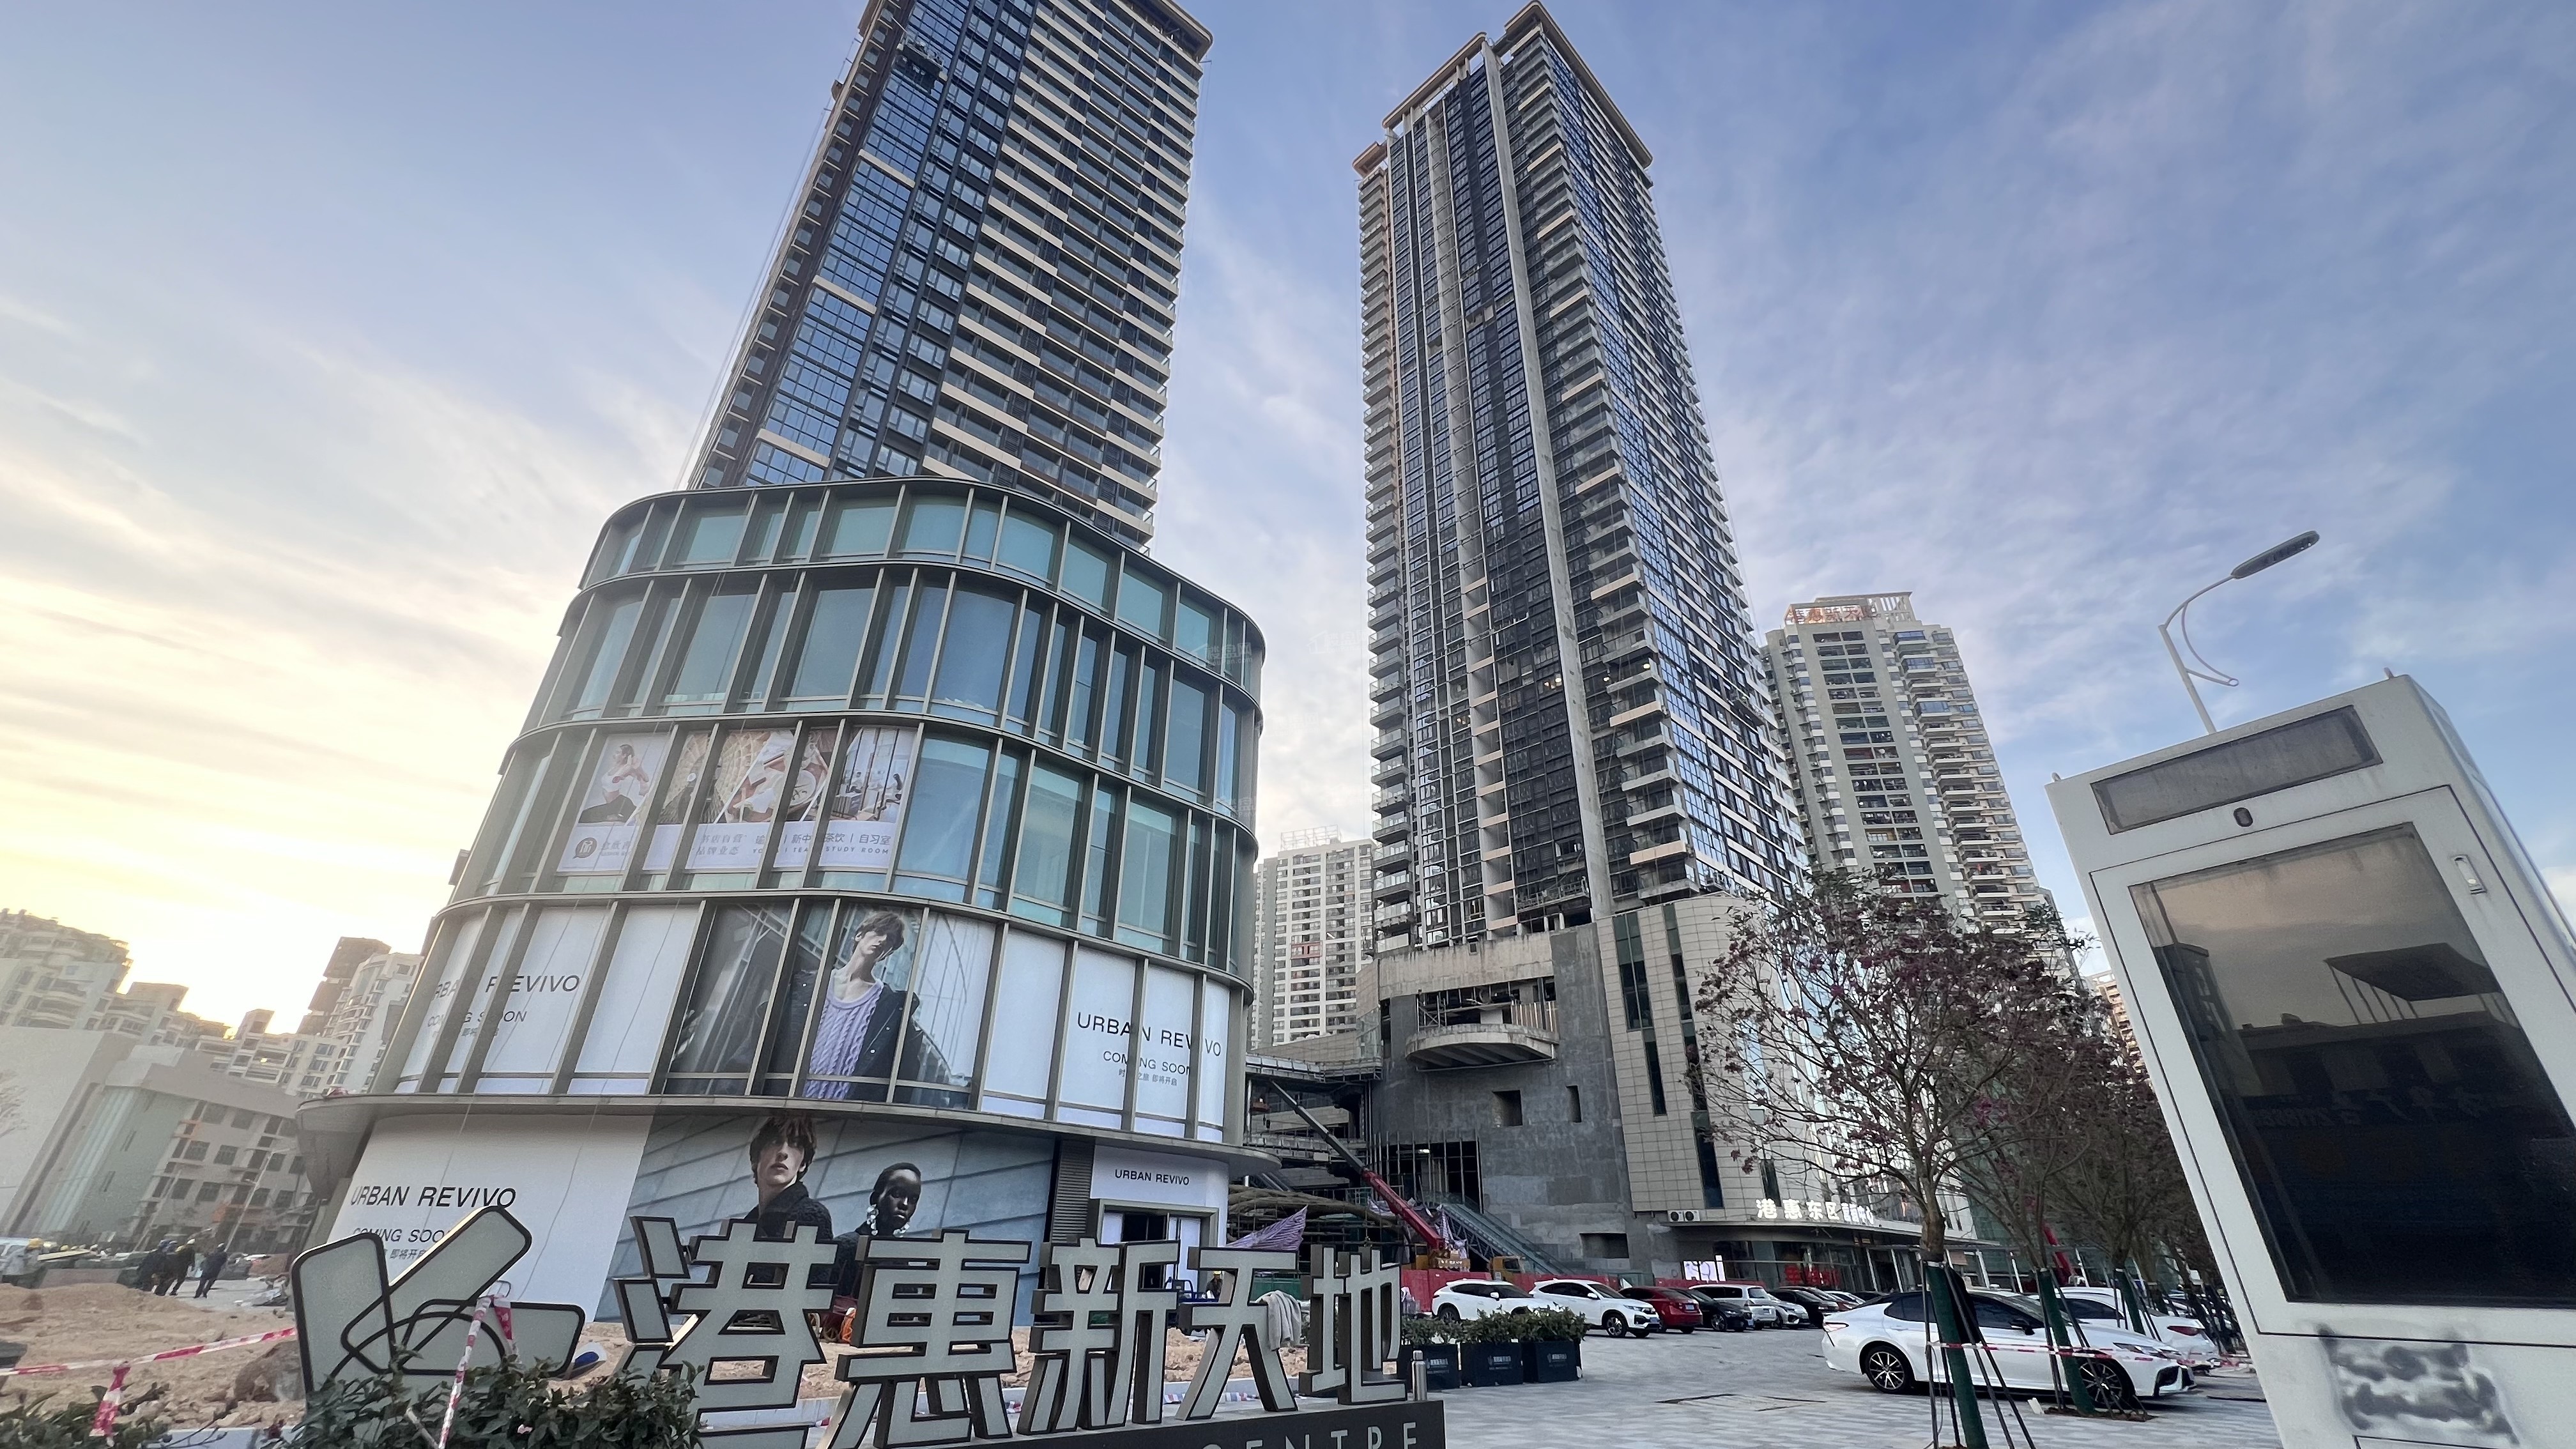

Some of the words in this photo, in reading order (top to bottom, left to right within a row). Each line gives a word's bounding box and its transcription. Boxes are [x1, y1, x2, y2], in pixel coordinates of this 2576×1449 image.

[859, 834, 891, 845] 自习室
[1115, 1169, 1152, 1181] URBAN
[1155, 1173, 1190, 1186] REVIVO
[351, 1186, 410, 1206] URBAN
[417, 1186, 516, 1209] REVIVO
